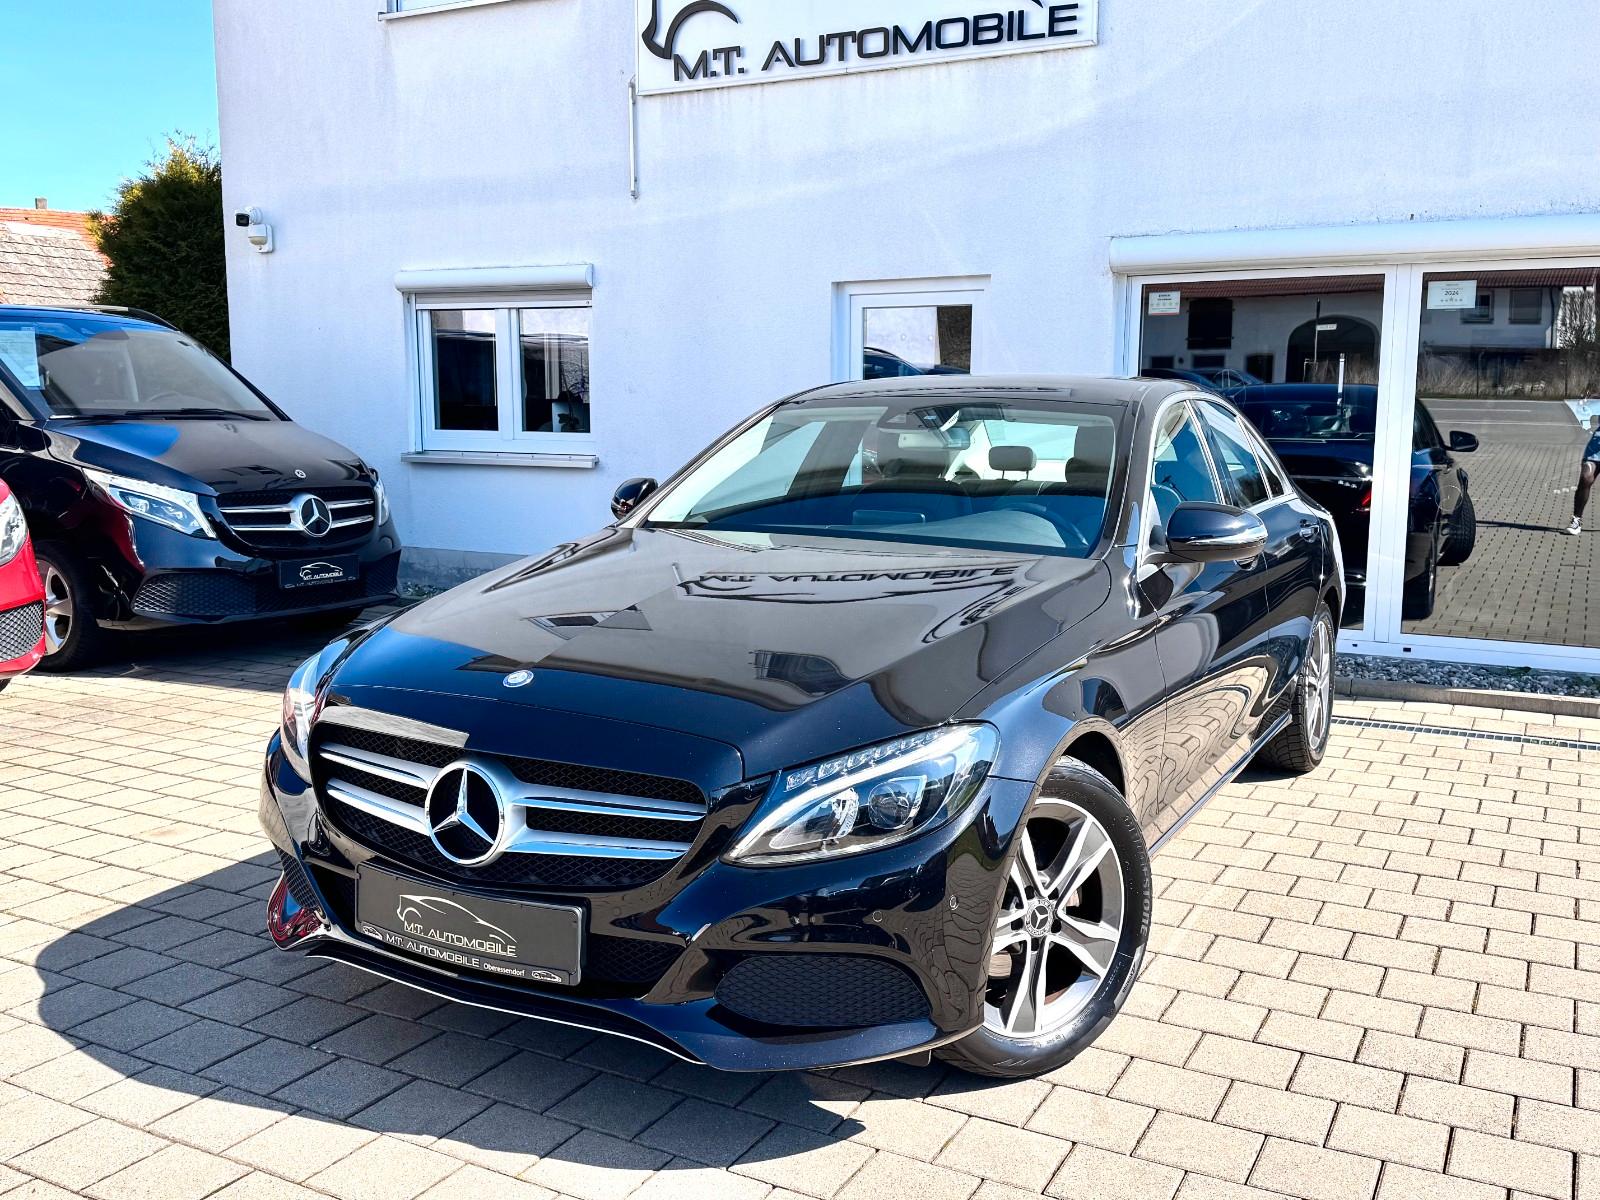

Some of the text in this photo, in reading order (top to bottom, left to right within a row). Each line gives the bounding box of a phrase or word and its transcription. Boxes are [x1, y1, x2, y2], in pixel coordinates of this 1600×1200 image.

[673, 3, 1079, 82] M.T. AUTOMOBILE
[386, 933, 526, 977] M.T. AUTOMOBILE Oberessendorf
[403, 920, 518, 957] M.T. AUTOMOBILE
